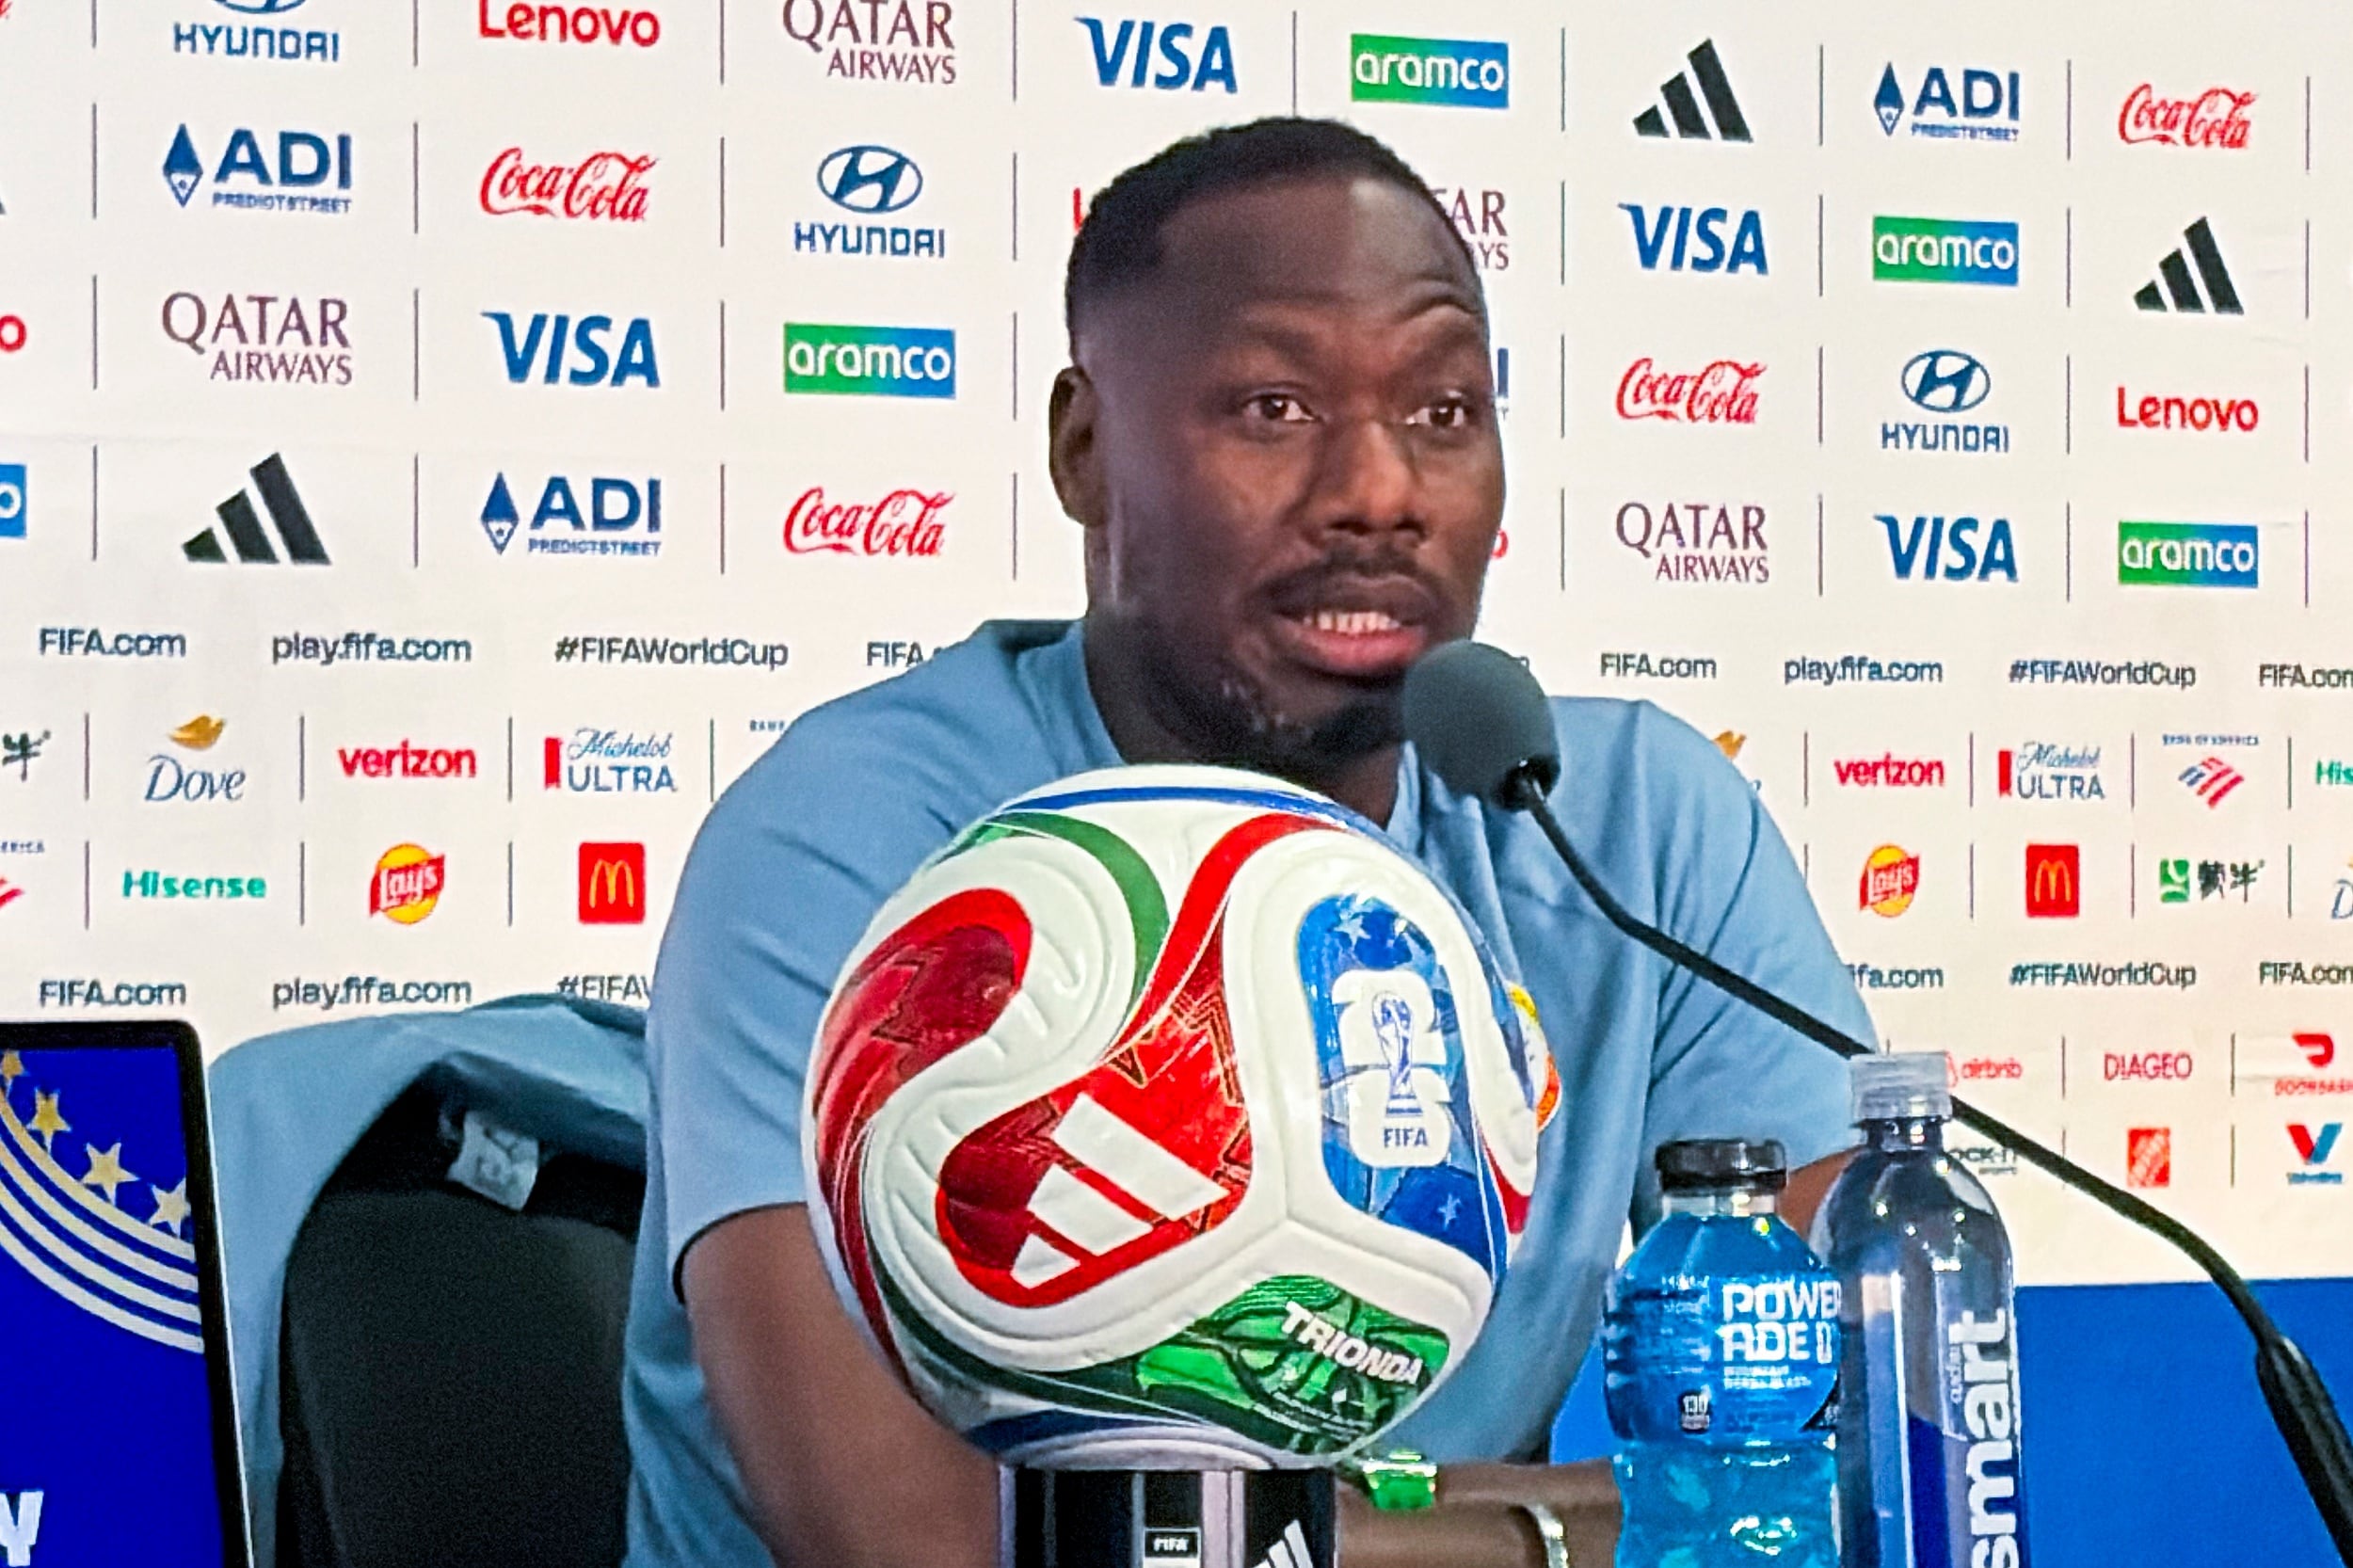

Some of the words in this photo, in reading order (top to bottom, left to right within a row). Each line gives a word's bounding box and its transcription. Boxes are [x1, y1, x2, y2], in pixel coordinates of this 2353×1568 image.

[479, 0, 661, 48] Lenovo
[783, 0, 954, 52] QATAR
[173, 23, 340, 62] HYUNDAI
[1074, 17, 1238, 94] VISA
[827, 50, 956, 85] AIRWAYS
[1355, 51, 1504, 91] aramco
[1913, 67, 2020, 121] ADI
[214, 128, 352, 187] ADI
[794, 222, 945, 258] HYUNDAI
[1617, 203, 1769, 276] VISA
[1878, 234, 2014, 270] aramco
[162, 292, 351, 355] QATAR
[480, 312, 660, 388] VISA
[789, 342, 951, 380] aramco
[210, 353, 352, 386] AIRWAYS
[2118, 386, 2259, 432] Lenovo
[1881, 423, 2009, 453] HYUNDAI
[530, 475, 661, 531] ADI
[1616, 502, 1768, 557] QATAR
[1873, 514, 2019, 583] VISA
[2122, 538, 2254, 572] aramco
[1657, 554, 1769, 584] AIRWAYS
[40, 628, 186, 657] FIFA.com
[272, 632, 472, 665] play.fifa.com
[553, 636, 788, 671] #FIFAWorldCup
[866, 641, 925, 667] FIFA
[1601, 652, 1717, 679] FIFA.com
[1785, 655, 1943, 686] play.fifa.com
[2009, 659, 2196, 690] #FIFAWorldCup
[337, 738, 477, 778] verizon
[568, 728, 672, 760] Michelob
[2017, 741, 2101, 769] Michelob
[144, 754, 246, 801] Dove
[568, 765, 676, 792] ULTRA
[1833, 752, 1945, 787] verizon
[2017, 774, 2105, 800] ULTRA
[122, 870, 266, 899] Hisense
[40, 979, 186, 1008] FIFA.com
[272, 976, 472, 1011] play.fifa.com
[2009, 962, 2196, 990] #FIFAWorldCup
[2105, 1052, 2193, 1080] DIAGEO
[1384, 1127, 1429, 1148] FIFA
[1281, 1301, 1423, 1385] TRIONDA
[1722, 1321, 1811, 1362] ADE
[1948, 1307, 2020, 1568] smart
